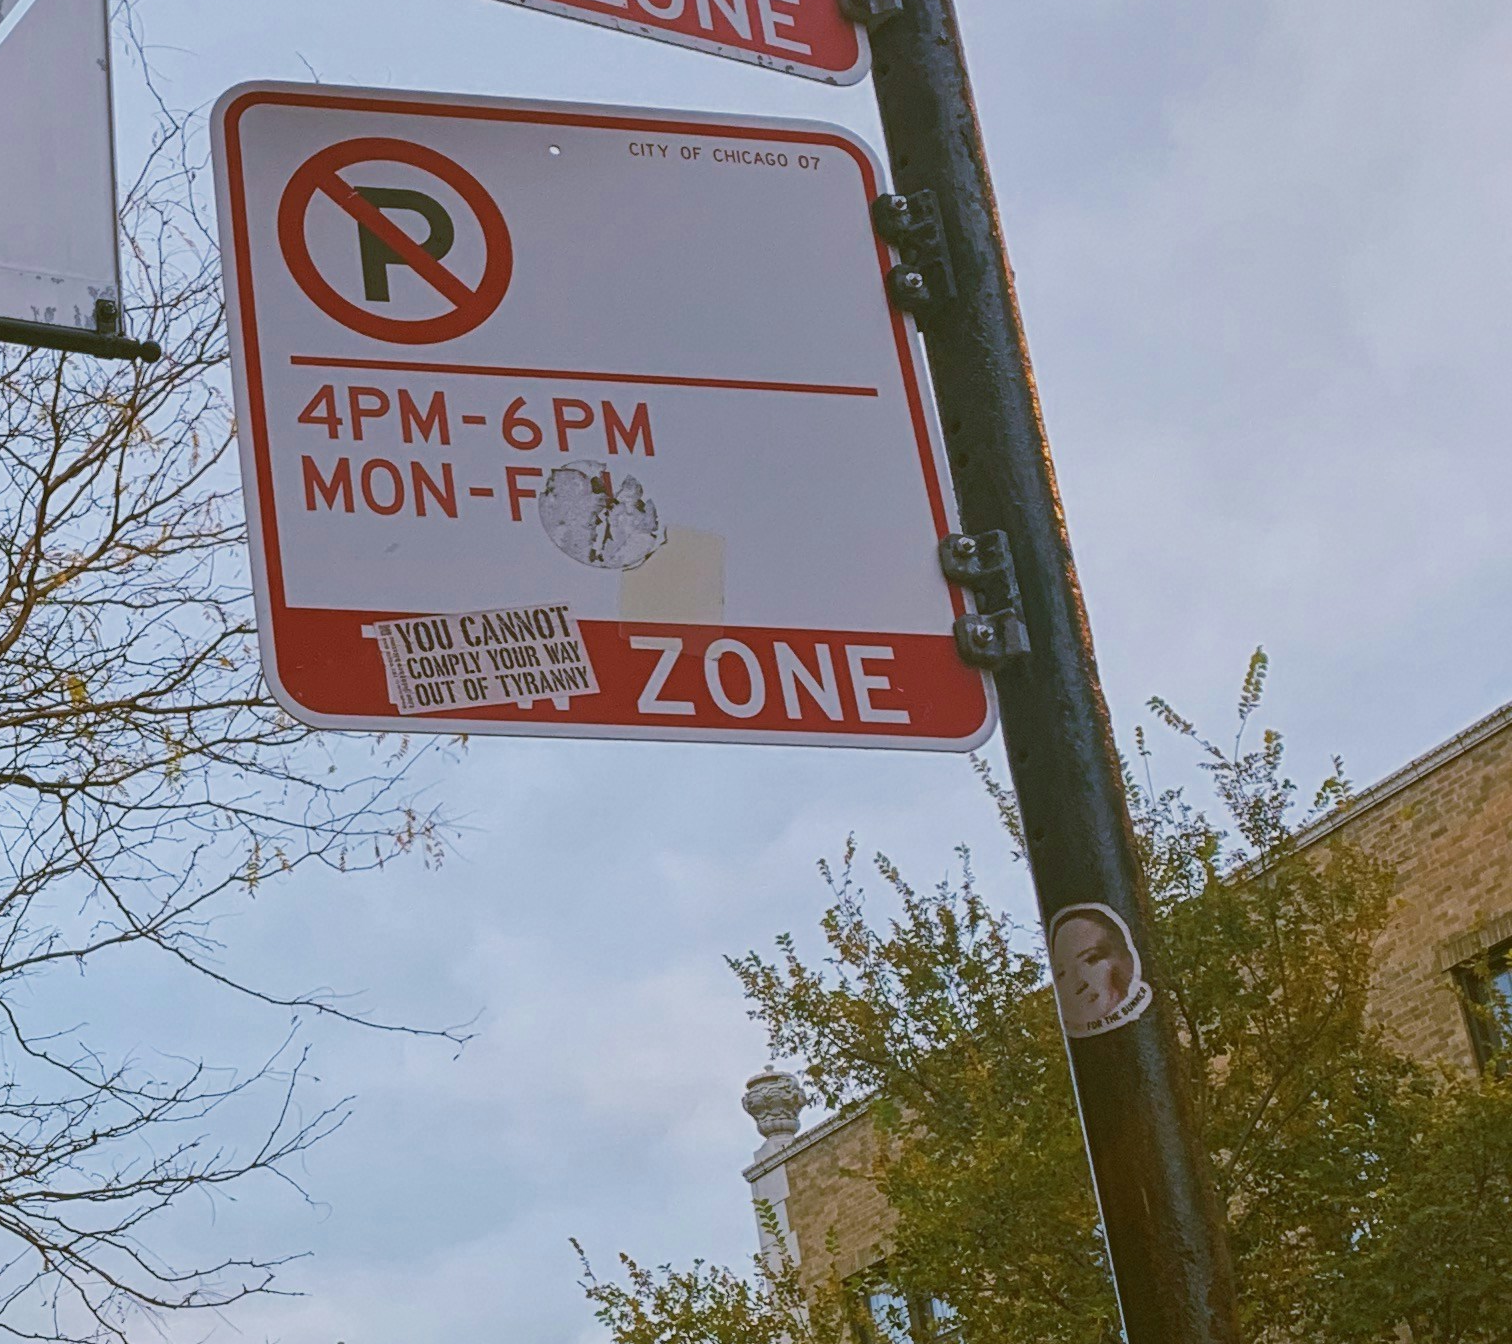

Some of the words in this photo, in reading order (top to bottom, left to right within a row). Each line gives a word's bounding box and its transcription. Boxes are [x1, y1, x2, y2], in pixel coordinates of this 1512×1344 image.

[629, 142, 669, 158] CITY
[680, 146, 702, 160] OF
[713, 148, 788, 167] CHICAGO
[798, 155, 821, 170] 07
[297, 384, 655, 457] 4PM-6PM
[394, 618, 454, 655] YOU
[459, 606, 569, 647] CANNOT
[406, 650, 483, 680] COMPLY
[487, 645, 541, 672] YOUR
[542, 640, 582, 665] WAY
[629, 635, 911, 725] ZONE
[414, 680, 456, 707] OUT
[463, 676, 489, 702] OF
[495, 665, 590, 698] TYRANNY
